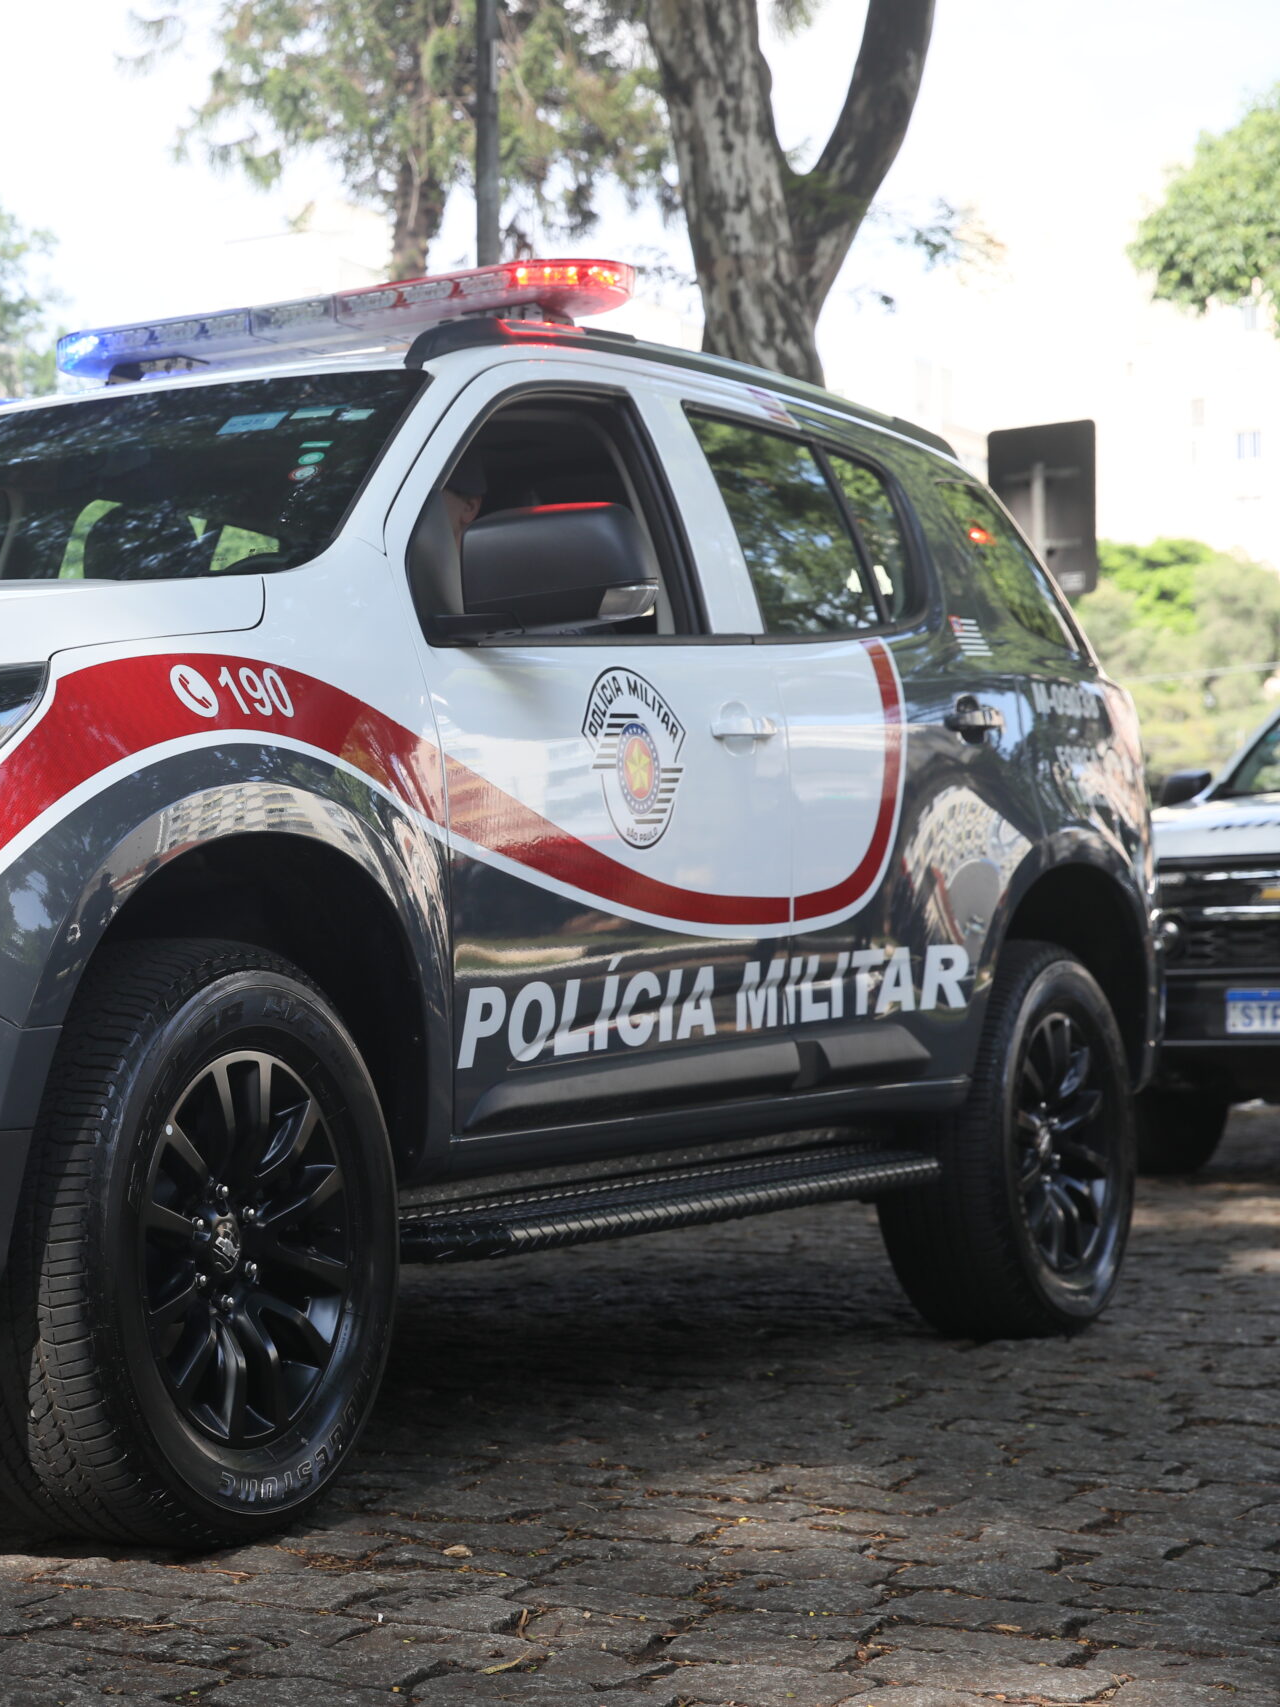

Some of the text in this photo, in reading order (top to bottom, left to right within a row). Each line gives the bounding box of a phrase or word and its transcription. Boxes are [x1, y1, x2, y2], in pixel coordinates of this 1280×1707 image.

[218, 666, 294, 718] 190
[588, 676, 678, 743] POLÍCIA MILITAR
[456, 943, 970, 1069] POLÍCIA MILITAR
